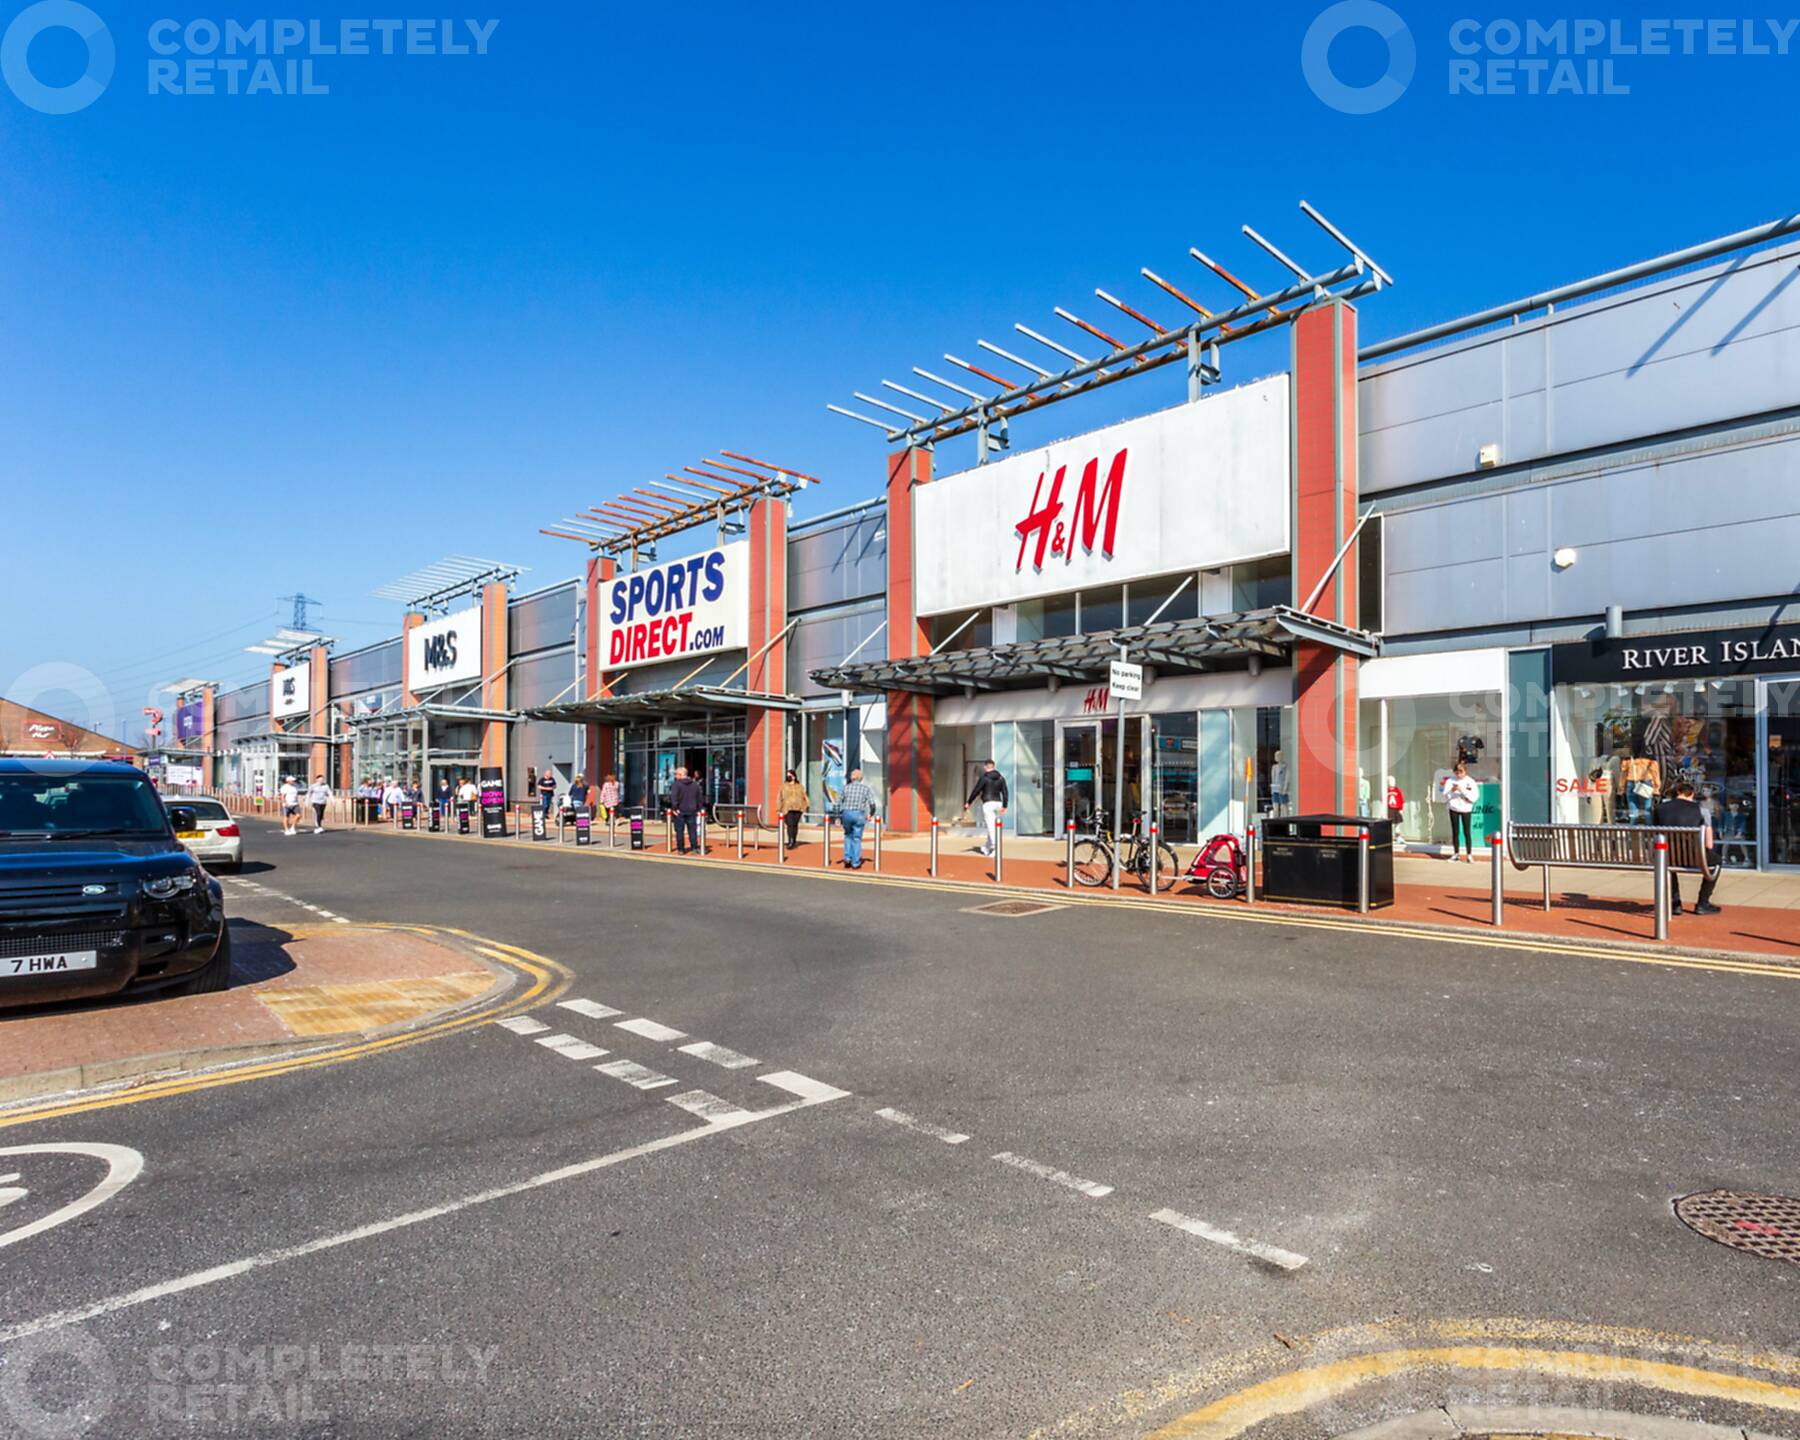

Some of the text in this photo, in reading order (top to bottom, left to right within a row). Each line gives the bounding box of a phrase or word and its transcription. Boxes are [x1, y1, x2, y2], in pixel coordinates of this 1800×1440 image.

[1014, 447, 1128, 575] H&M
[610, 551, 726, 625] SPORTS
[424, 629, 458, 671] M&S
[1622, 646, 1710, 670] RIVER
[1121, 671, 1141, 680] parking
[1084, 688, 1109, 713] H&M
[481, 779, 502, 787] GAME
[1556, 777, 1608, 793] SALE
[533, 810, 544, 836] GAME
[11, 956, 68, 973] 7 HWA
